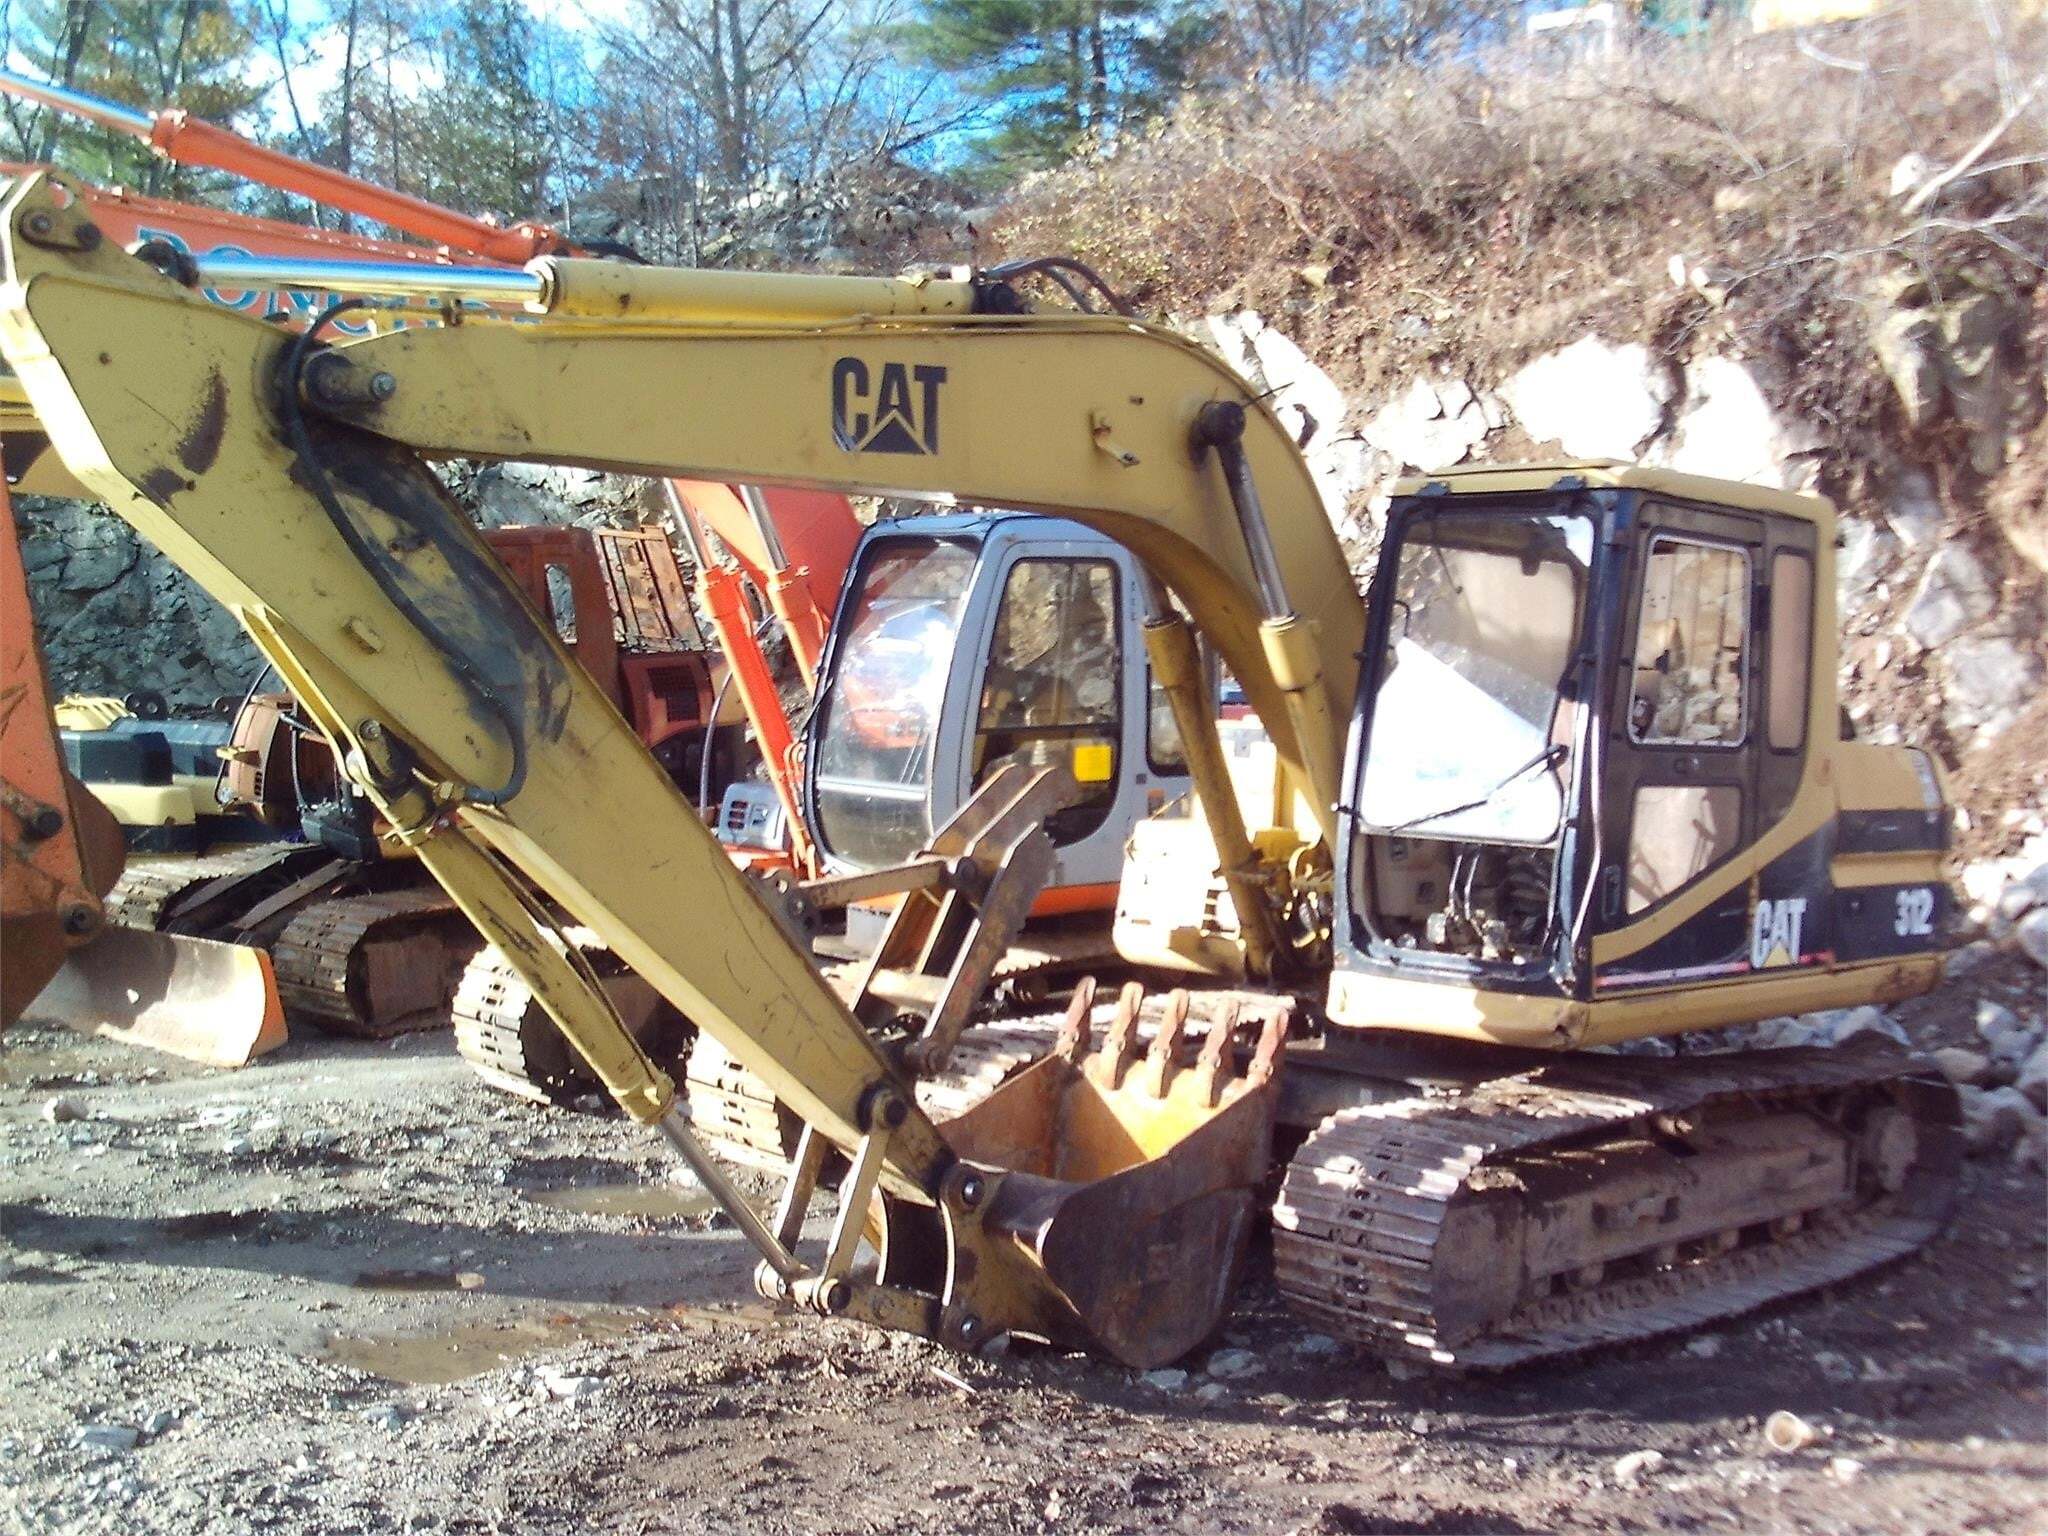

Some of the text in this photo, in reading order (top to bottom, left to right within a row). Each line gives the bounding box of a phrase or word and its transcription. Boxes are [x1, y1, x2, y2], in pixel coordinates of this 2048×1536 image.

[832, 357, 948, 455] CAT
[1752, 898, 1807, 968] CAT
[1895, 888, 1935, 936] 312
